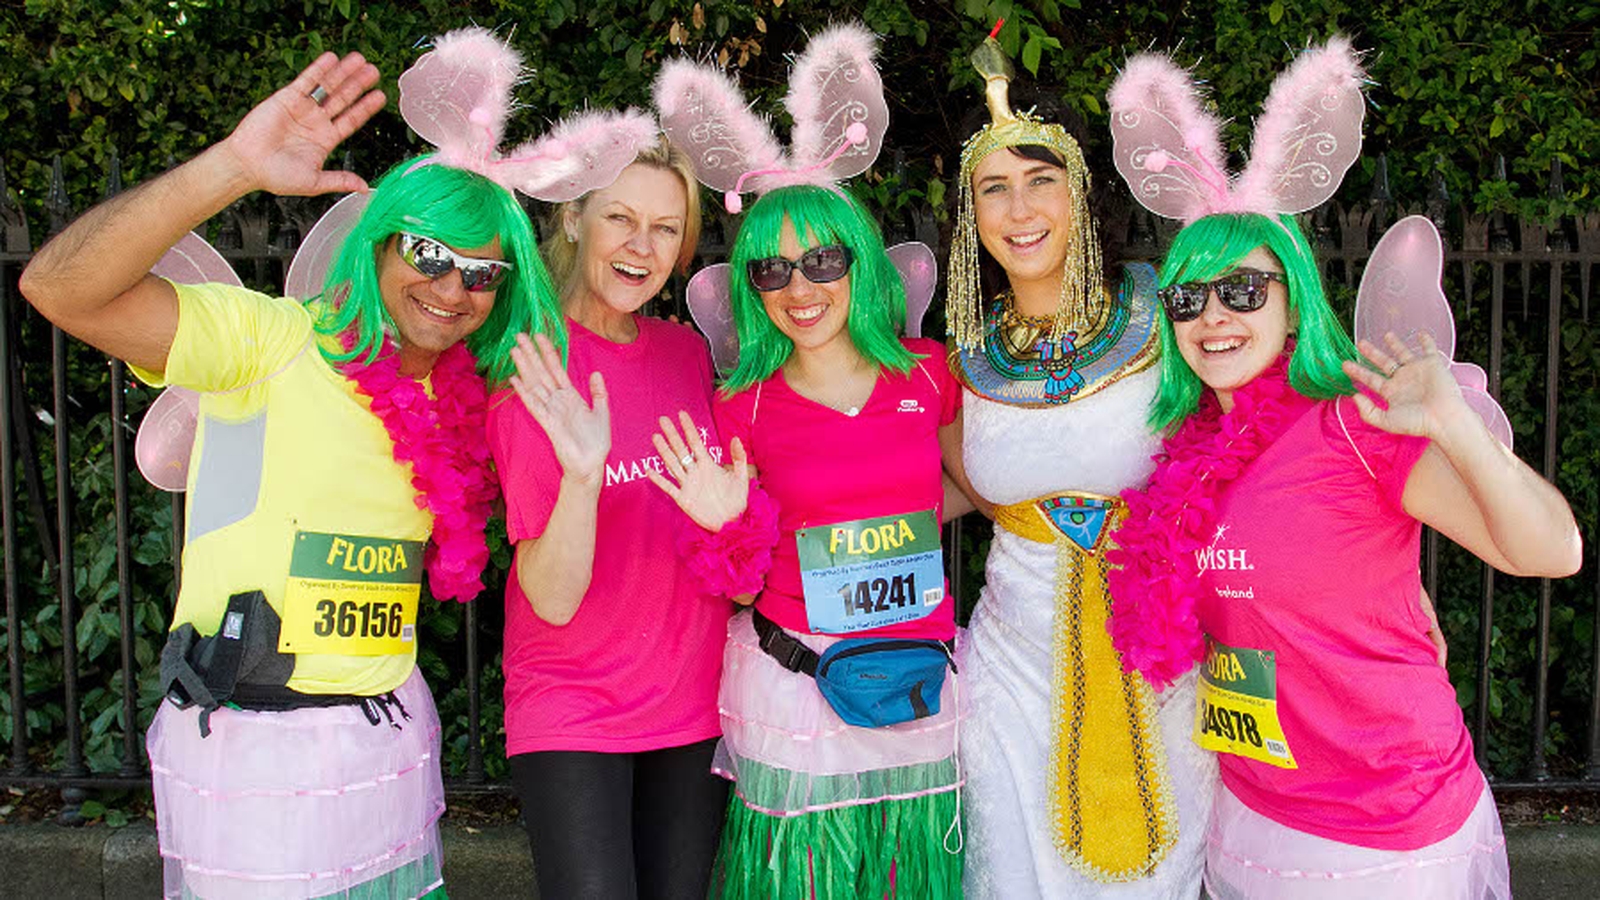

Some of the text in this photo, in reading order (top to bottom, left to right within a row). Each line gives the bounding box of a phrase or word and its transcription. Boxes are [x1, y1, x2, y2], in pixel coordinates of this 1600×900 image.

[709, 446, 723, 465] SH
[829, 518, 916, 555] FLORA
[326, 537, 408, 574] FLORA
[837, 572, 917, 617] 14241
[314, 599, 403, 638] 36156
